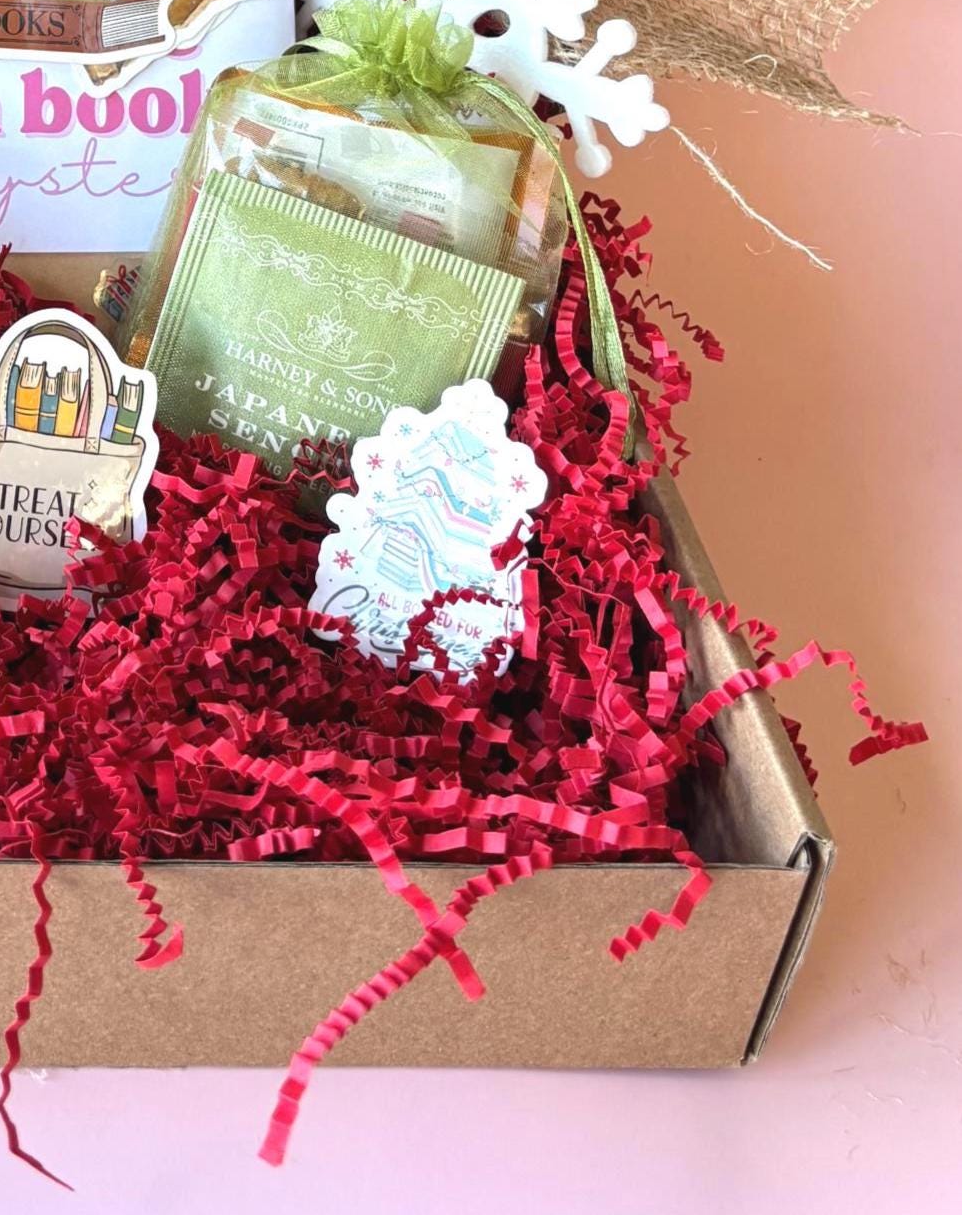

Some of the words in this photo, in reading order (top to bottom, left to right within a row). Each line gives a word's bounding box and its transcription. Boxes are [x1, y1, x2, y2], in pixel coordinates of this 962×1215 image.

[224, 337, 319, 388] HARNEY
[320, 378, 338, 398] &
[378, 592, 398, 611] ALL
[456, 620, 483, 640] FOR
